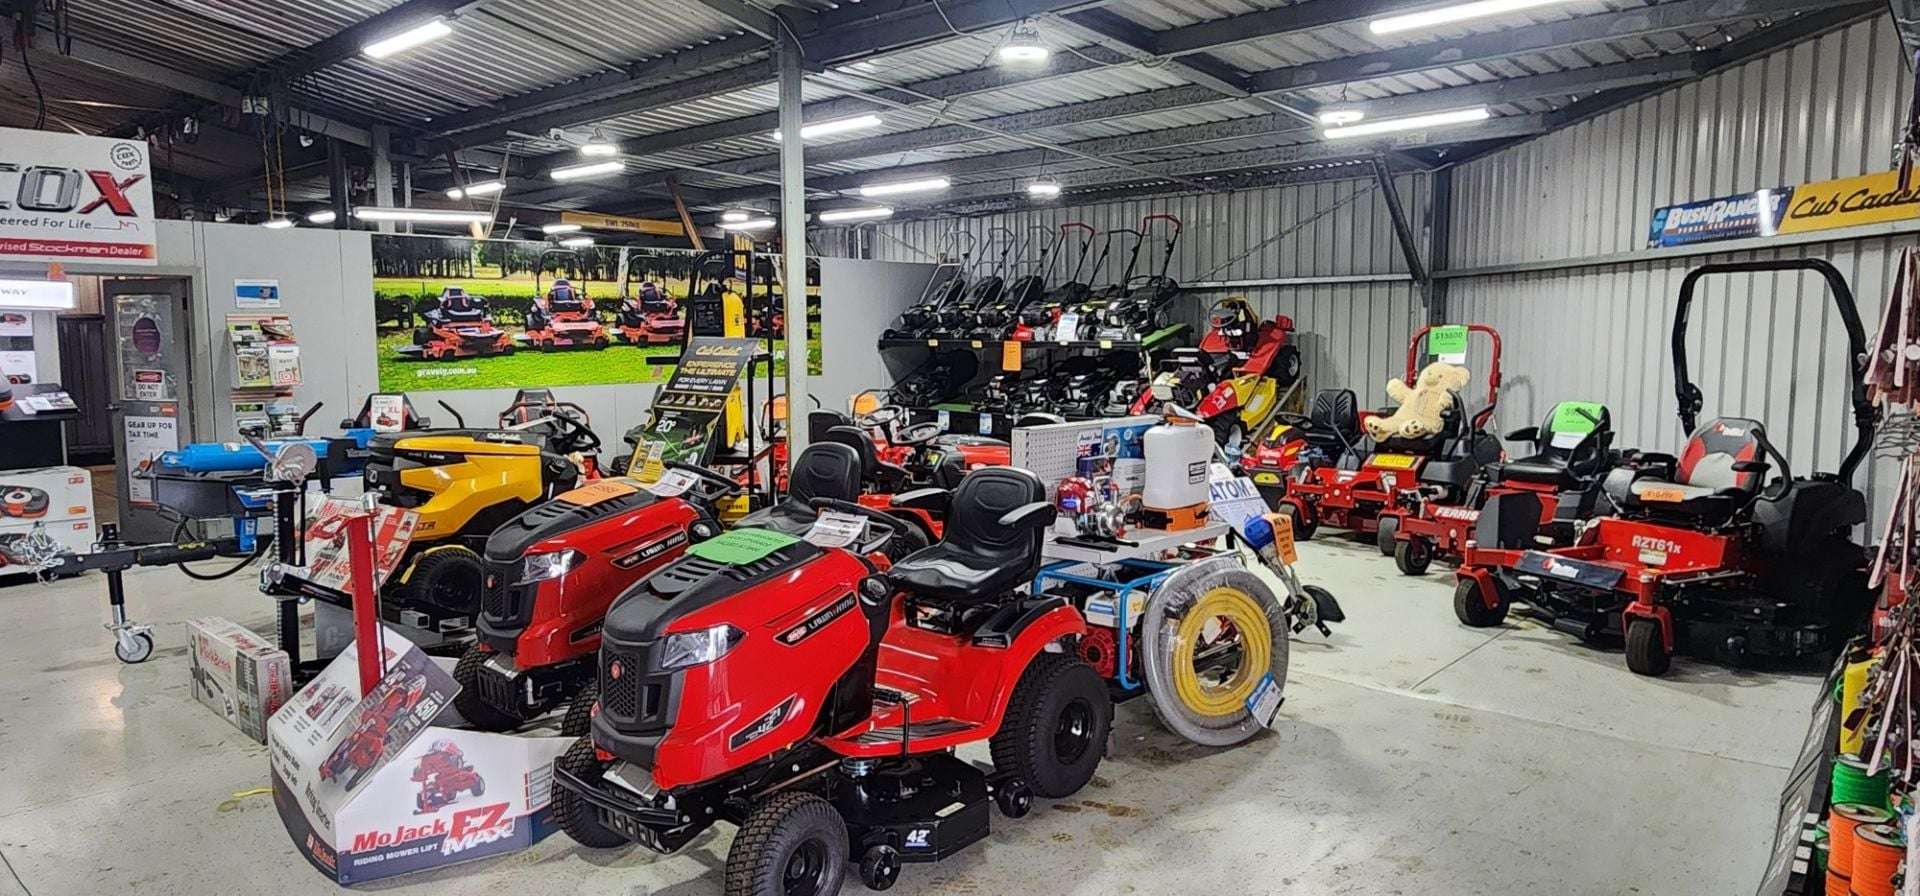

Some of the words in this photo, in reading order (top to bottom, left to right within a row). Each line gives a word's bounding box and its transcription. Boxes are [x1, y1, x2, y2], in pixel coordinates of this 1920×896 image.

[0, 163, 146, 217] OX
[1791, 191, 1841, 219] Cub
[43, 218, 65, 229] For
[68, 219, 92, 230] Life
[28, 242, 110, 255] Stockman
[110, 246, 143, 256] Dealer
[685, 360, 737, 369] EXPERIENCE
[416, 368, 477, 378] gravely.com.au
[680, 368, 696, 376] THE
[696, 369, 737, 377] ULTIMATE
[128, 421, 146, 430] GEAR
[148, 421, 157, 430] UP
[159, 421, 173, 430] FOR
[129, 431, 142, 439] TAX
[143, 431, 158, 439] TIME
[1210, 479, 1251, 500] ATOM
[1435, 507, 1480, 521] FERRIS
[353, 855, 385, 867] RIDING
[386, 849, 419, 861] MOWER
[420, 843, 438, 854] LIFT
